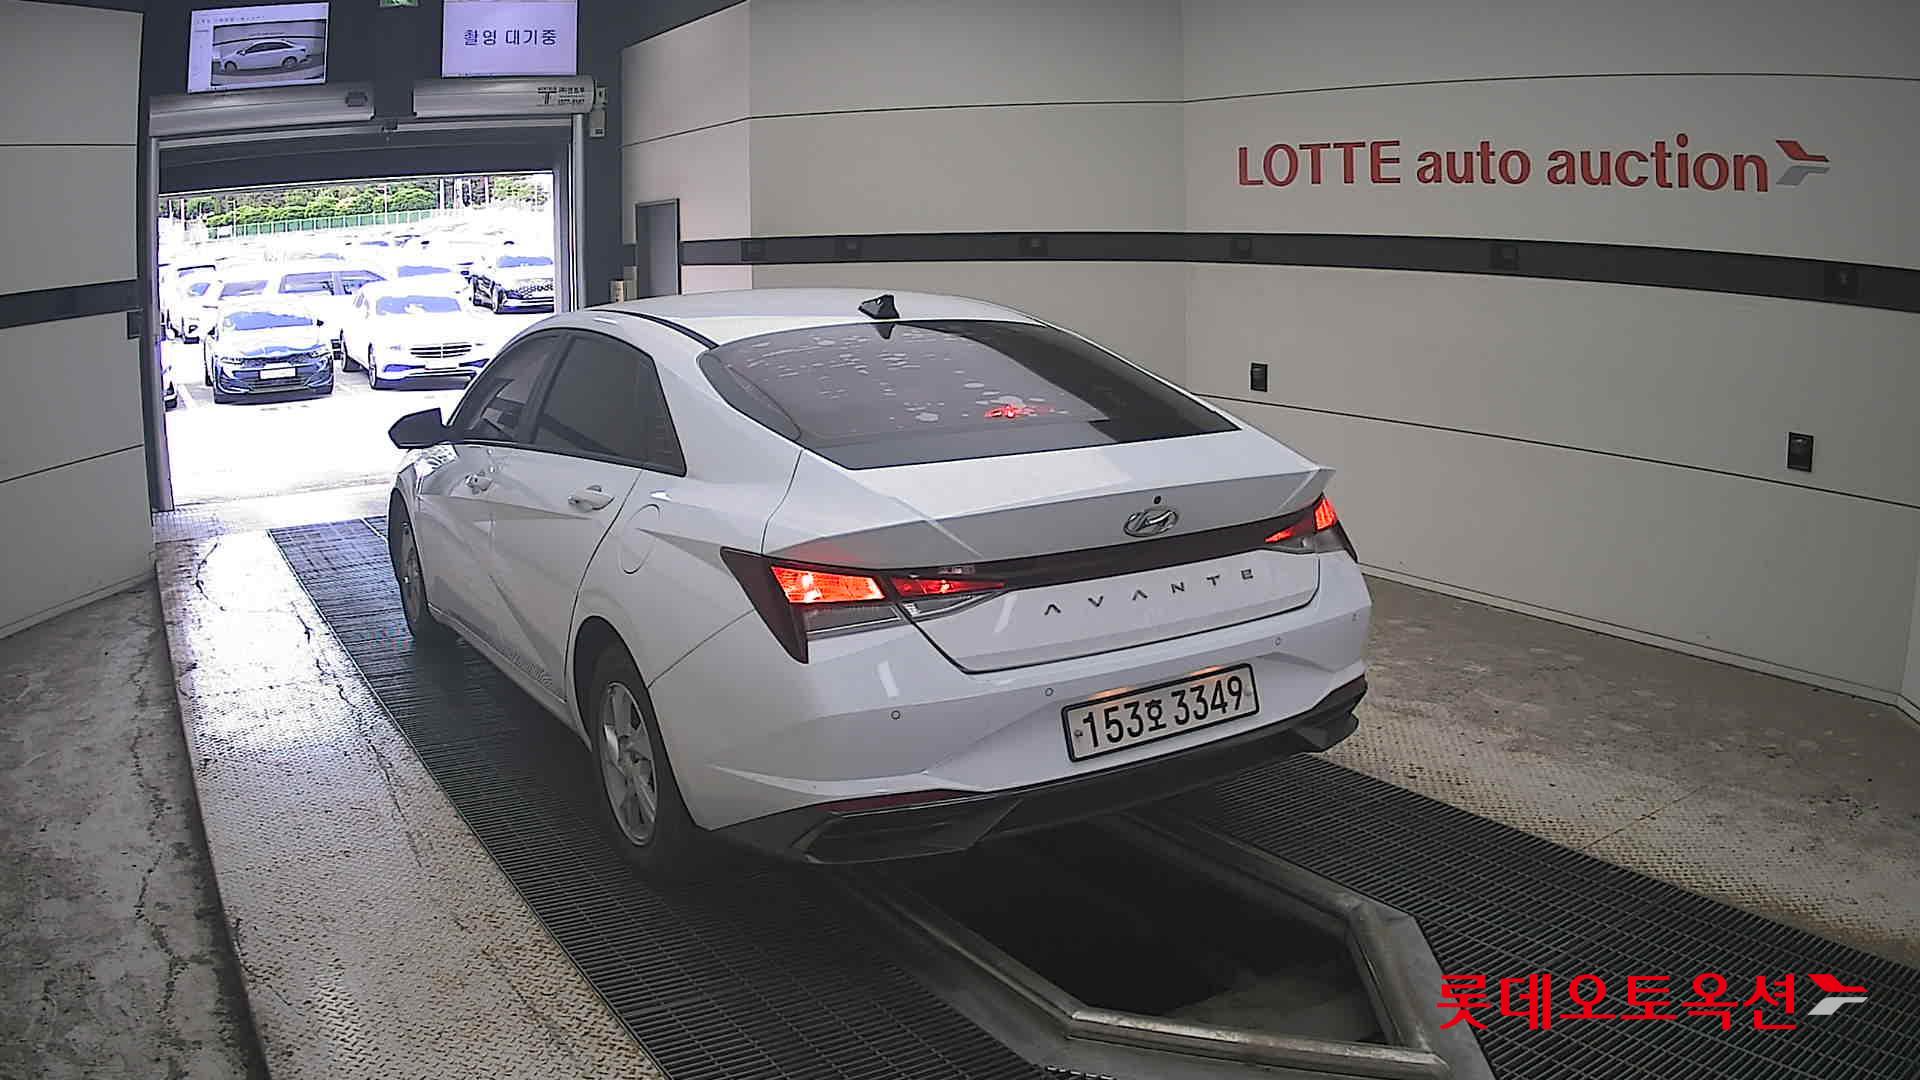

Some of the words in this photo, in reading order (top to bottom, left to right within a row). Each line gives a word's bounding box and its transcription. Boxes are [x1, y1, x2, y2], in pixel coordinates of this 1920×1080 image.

[505, 29, 557, 46] 대기중
[1238, 140, 1401, 187] LOTTE
[1416, 141, 1531, 186] auto
[1547, 133, 1769, 192] auction
[1044, 568, 1254, 616] AVANTE
[1082, 699, 1167, 748] 153호
[1170, 675, 1244, 726] 3349
